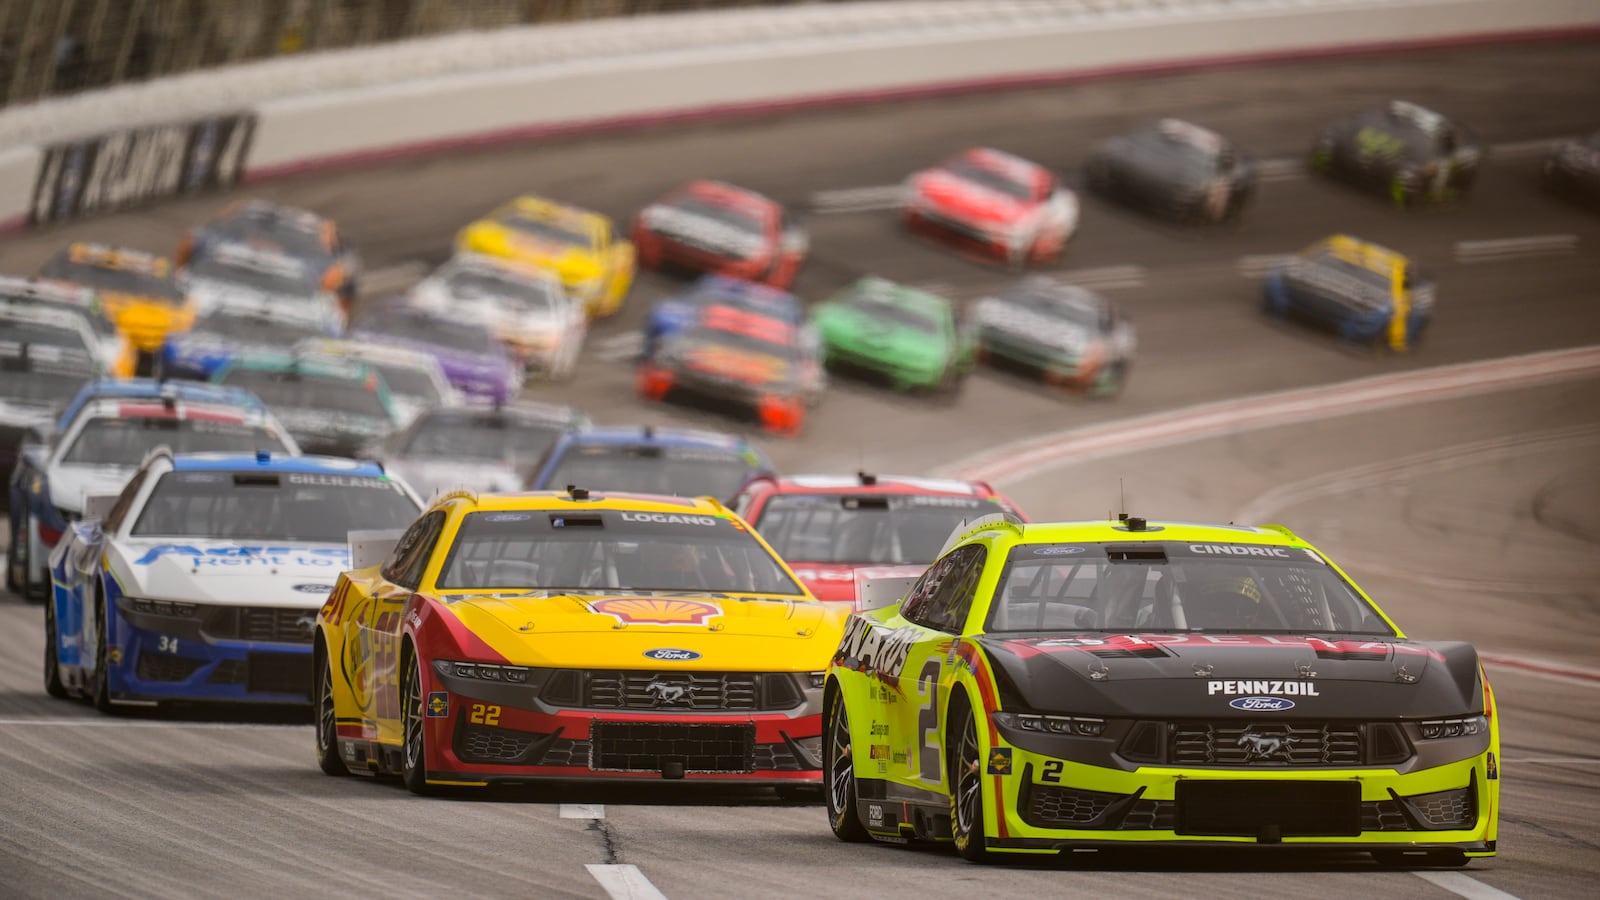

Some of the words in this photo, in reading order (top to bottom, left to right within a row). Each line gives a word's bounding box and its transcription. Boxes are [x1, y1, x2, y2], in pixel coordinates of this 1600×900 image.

[621, 512, 717, 526] LOGANO
[1189, 544, 1290, 558] CINDRIC
[158, 636, 178, 653] 34
[652, 648, 693, 662] Ford
[1207, 680, 1320, 697] PENNZOIL
[1238, 696, 1284, 711] Ford
[470, 704, 502, 726] 22
[916, 655, 943, 784] 2
[1041, 760, 1064, 783] 2
[869, 804, 883, 821] FORD
